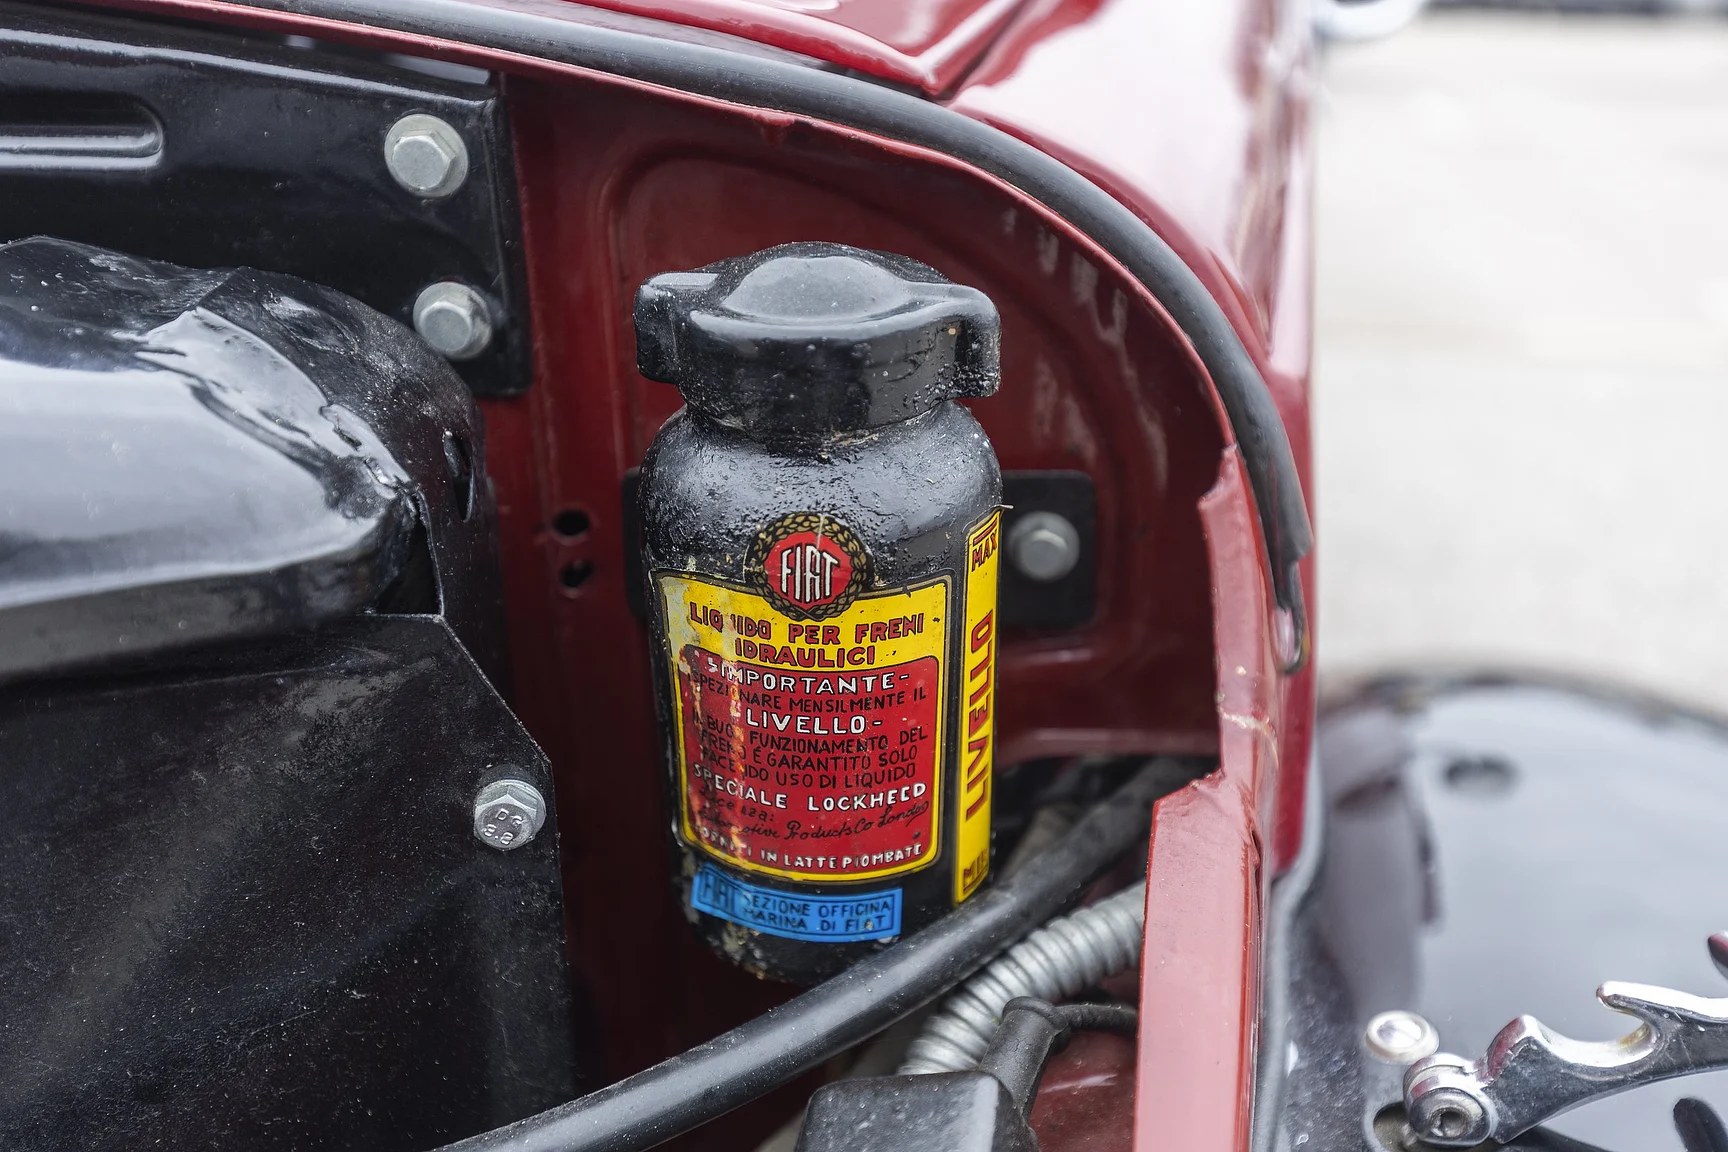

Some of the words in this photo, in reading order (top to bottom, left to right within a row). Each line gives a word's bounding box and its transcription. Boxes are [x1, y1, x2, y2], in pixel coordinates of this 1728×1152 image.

[971, 528, 998, 572] MAX
[780, 543, 840, 604] FIAT
[788, 623, 841, 646] PER
[854, 612, 924, 645] FRENI
[734, 637, 876, 669] IDRAULICI
[687, 668, 782, 711] ISPEZINARE
[789, 691, 905, 713] MENSILMENTE
[913, 686, 928, 702] IL
[707, 714, 741, 740] BUO
[749, 730, 888, 754] FUNZIONAMENTO
[899, 726, 928, 746] DEL
[965, 608, 994, 822] LIVELLO
[767, 752, 871, 773] GARANTITO
[879, 744, 918, 768] SOLO
[776, 770, 813, 788] USO
[819, 774, 837, 789] DI
[844, 762, 916, 789] LIQUIDO
[693, 762, 788, 810] SPECIALE
[807, 782, 927, 813] LOCKHEED
[784, 820, 853, 840] Products
[877, 801, 930, 828] London
[761, 848, 778, 863] IN
[783, 854, 837, 869] LATTE
[840, 842, 923, 869] PIOMBATE
[703, 871, 739, 913] FIAT
[817, 900, 892, 918] OFFICINA
[820, 919, 836, 932] DI
